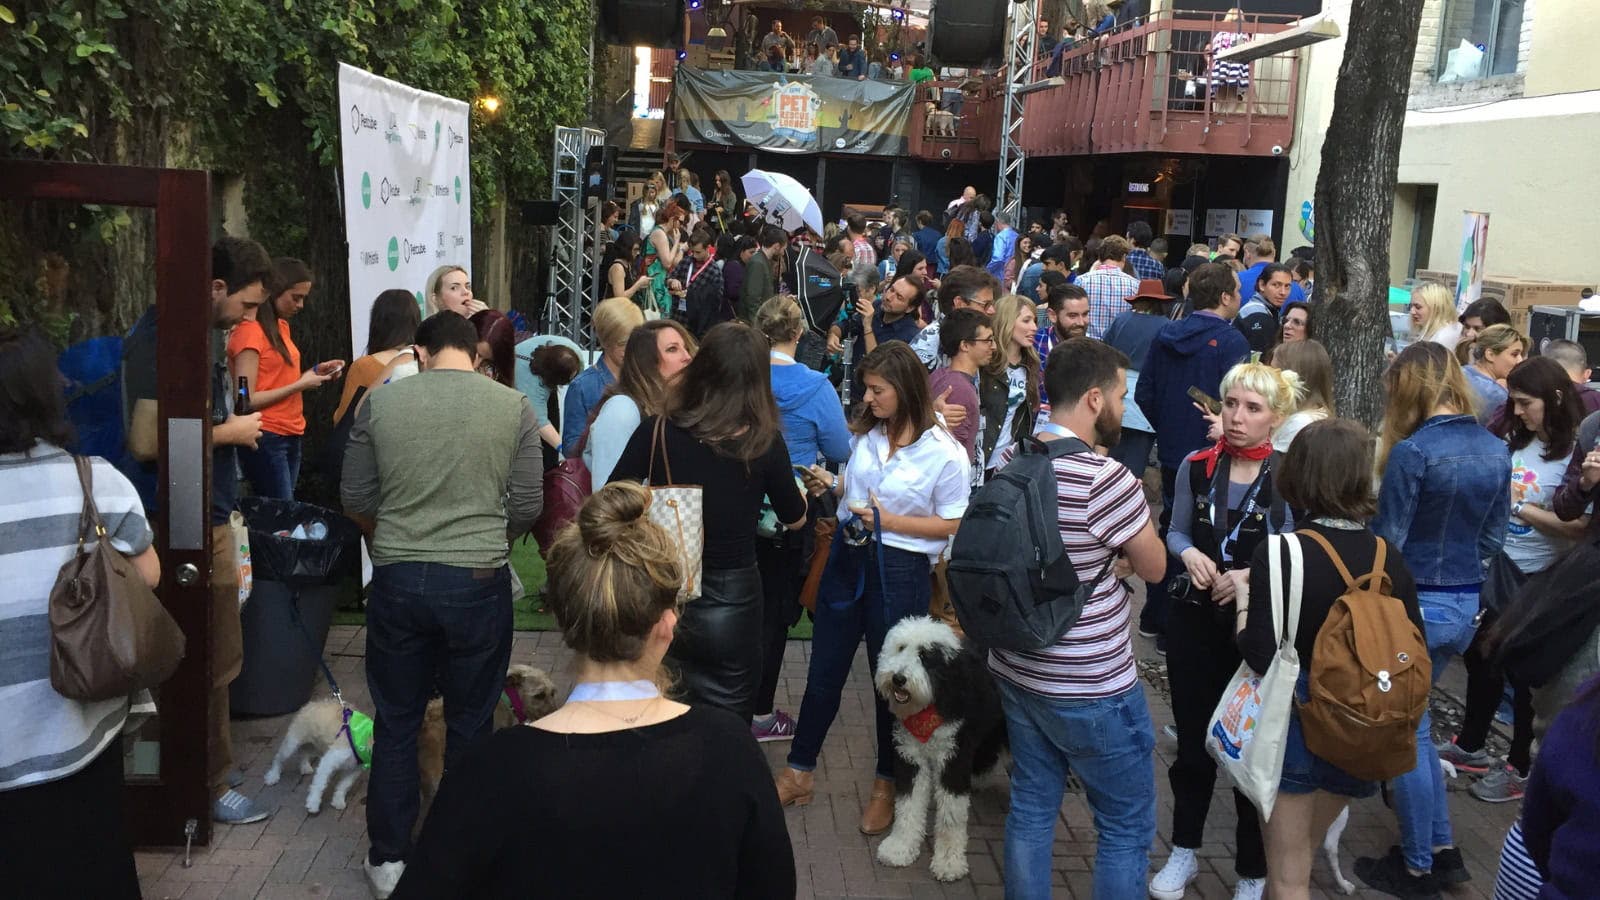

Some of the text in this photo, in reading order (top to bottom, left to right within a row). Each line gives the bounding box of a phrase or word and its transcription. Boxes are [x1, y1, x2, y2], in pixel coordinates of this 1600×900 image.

[780, 94, 809, 112] PET
[360, 113, 377, 130] Petcube
[410, 243, 427, 257] Petcube
